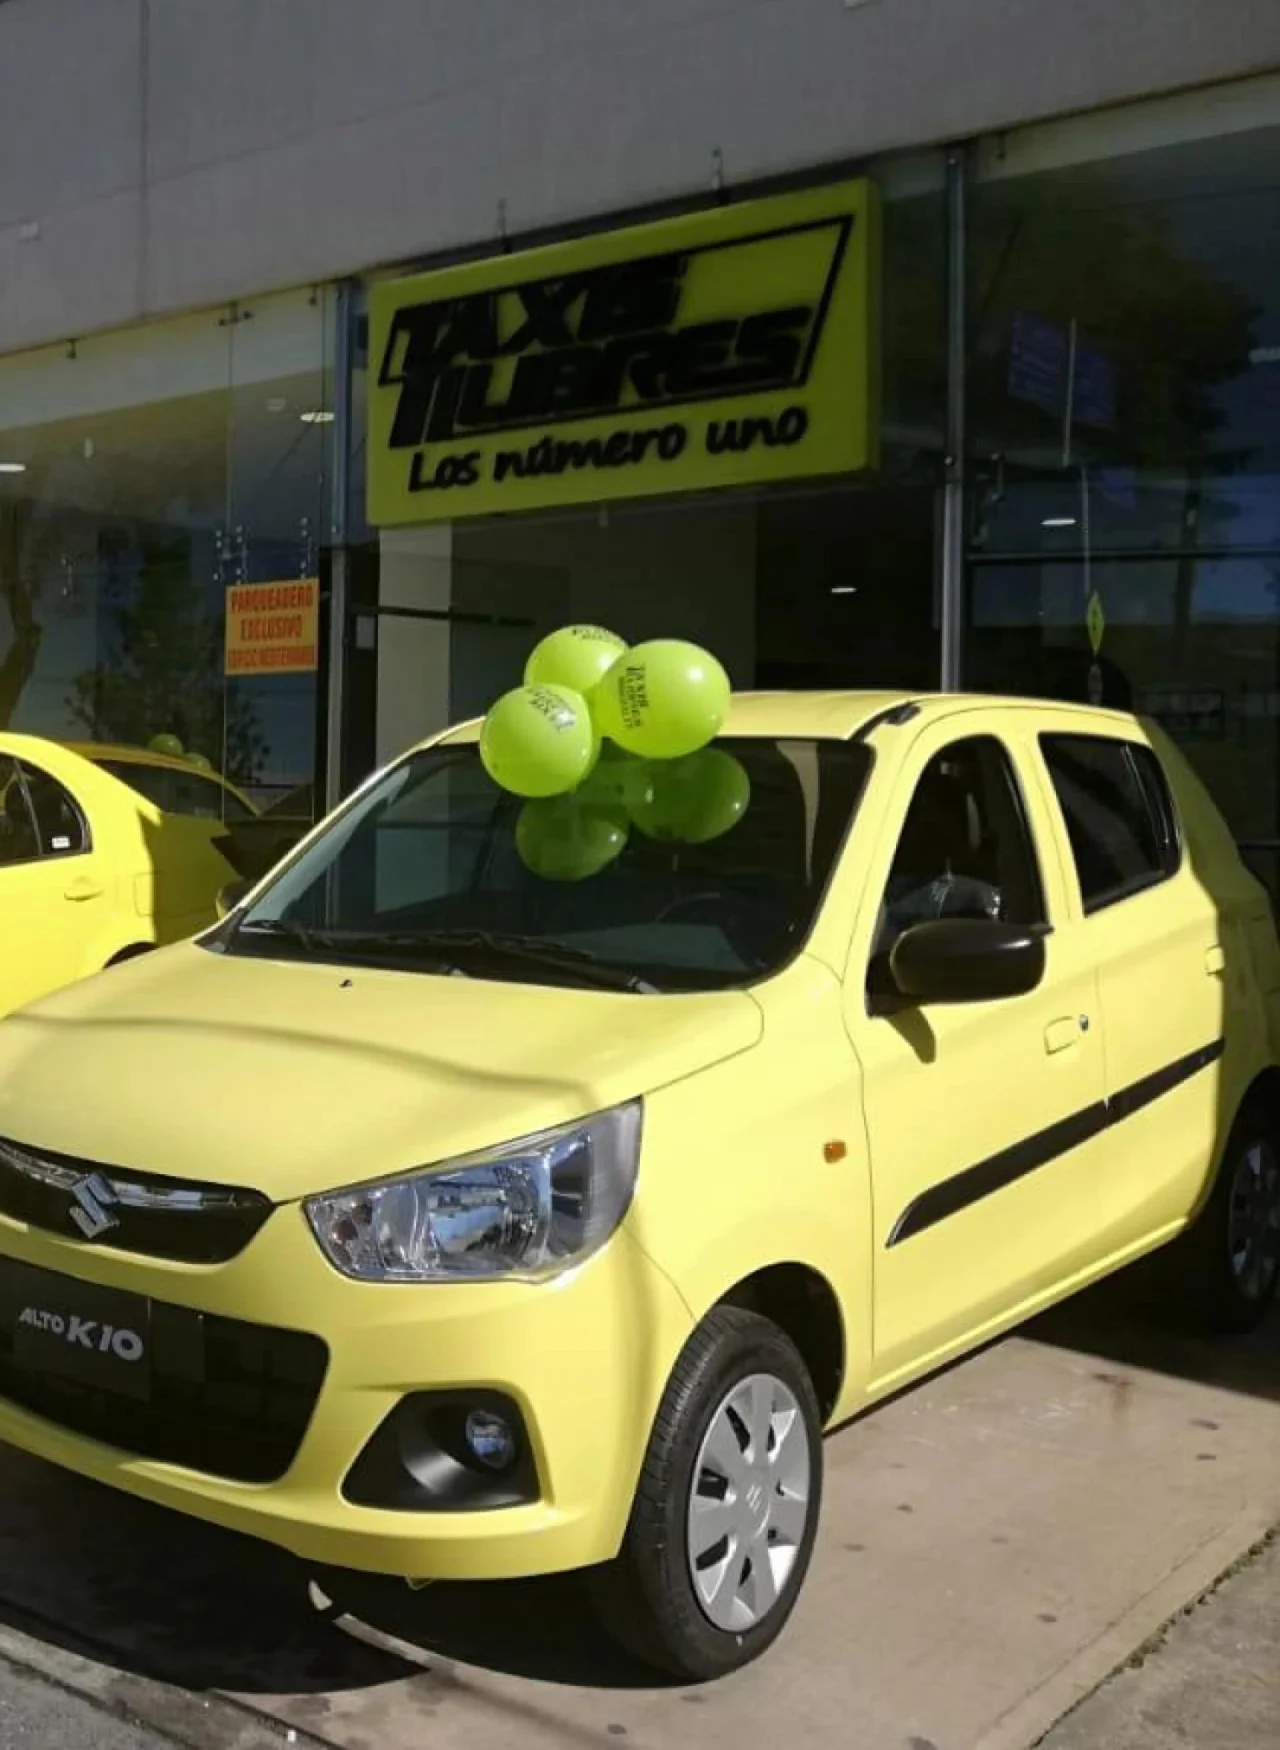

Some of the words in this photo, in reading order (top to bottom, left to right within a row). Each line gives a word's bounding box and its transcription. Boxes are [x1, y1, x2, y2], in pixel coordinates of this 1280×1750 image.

[408, 450, 480, 493] Los
[492, 423, 687, 481] número
[705, 406, 809, 454] uno
[19, 1307, 65, 1335] ALTO
